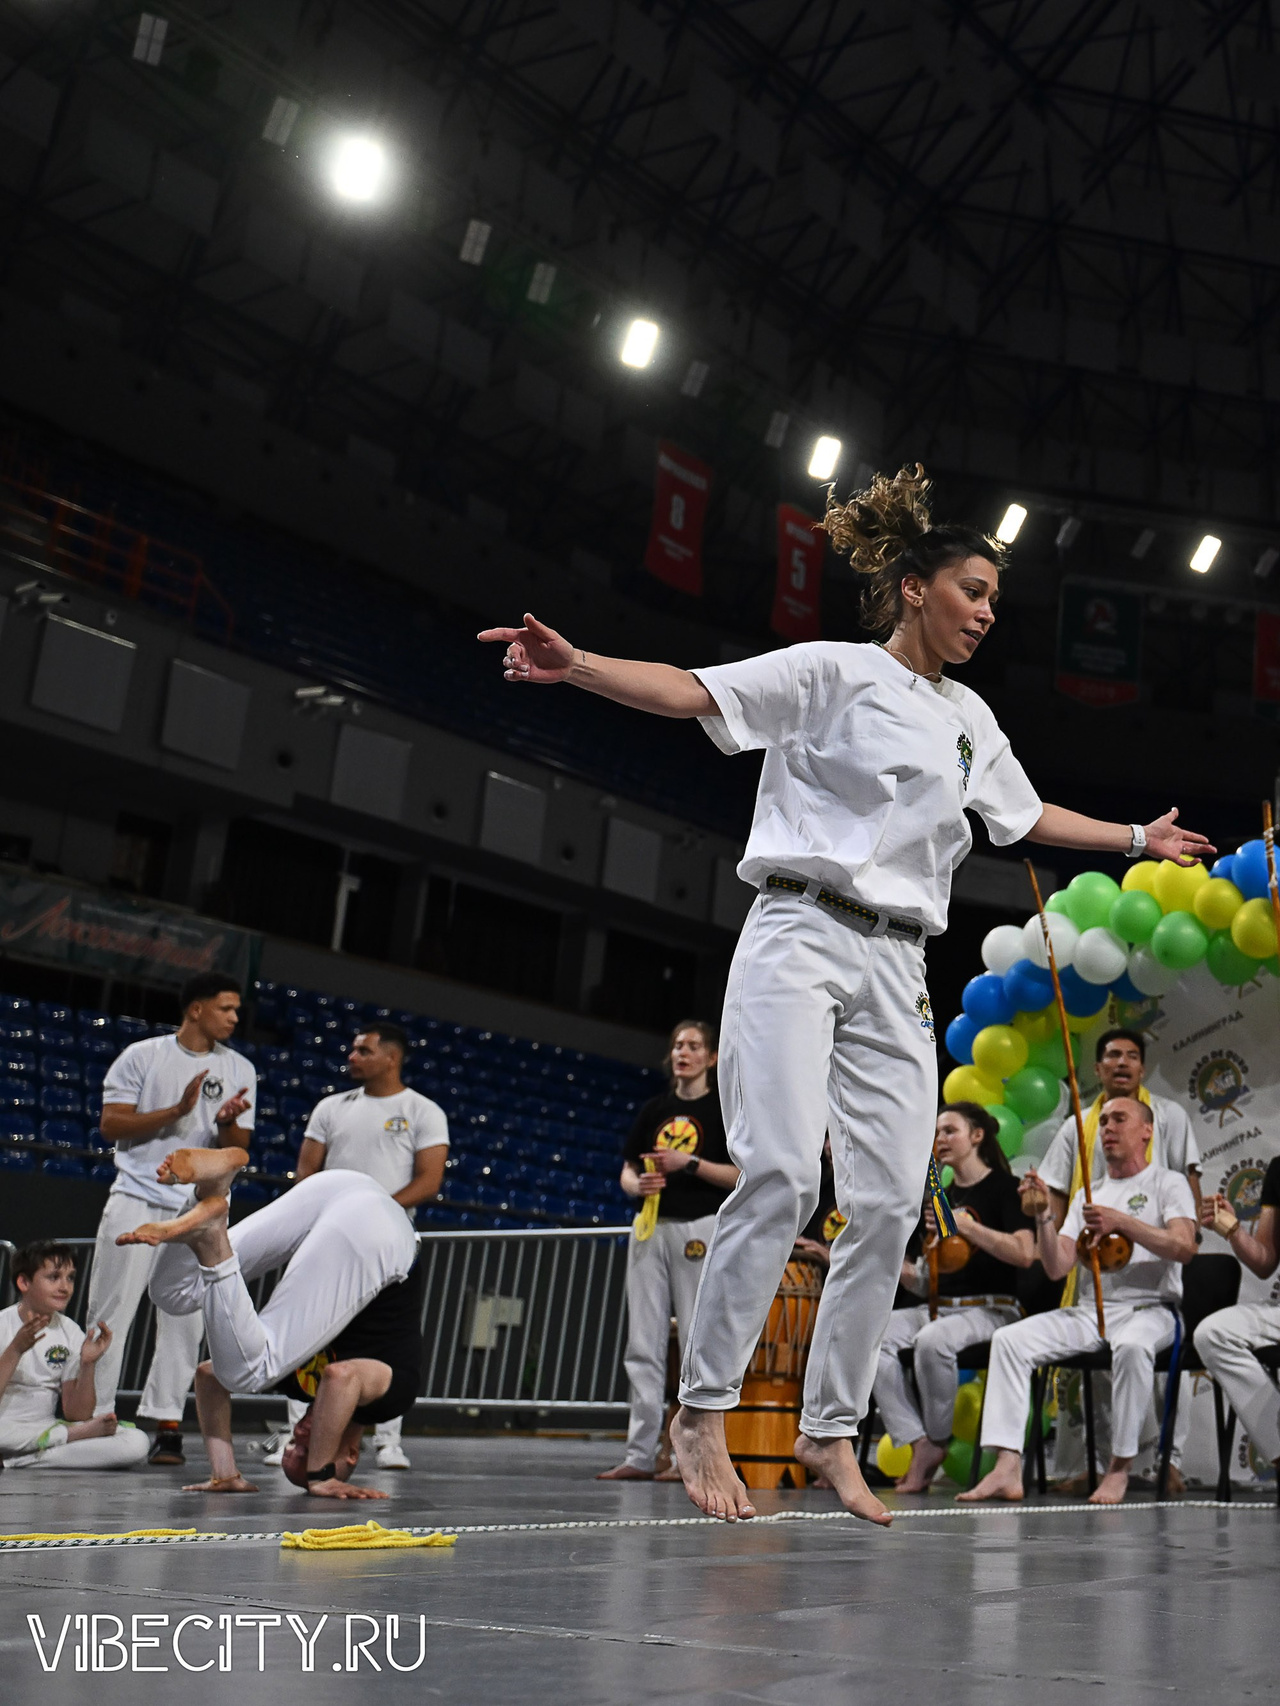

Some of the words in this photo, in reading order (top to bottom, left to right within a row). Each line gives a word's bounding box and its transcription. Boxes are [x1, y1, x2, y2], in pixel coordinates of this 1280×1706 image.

[791, 547, 807, 591] 5
[1210, 1049, 1224, 1058] DE
[1240, 1157, 1253, 1168] DE
